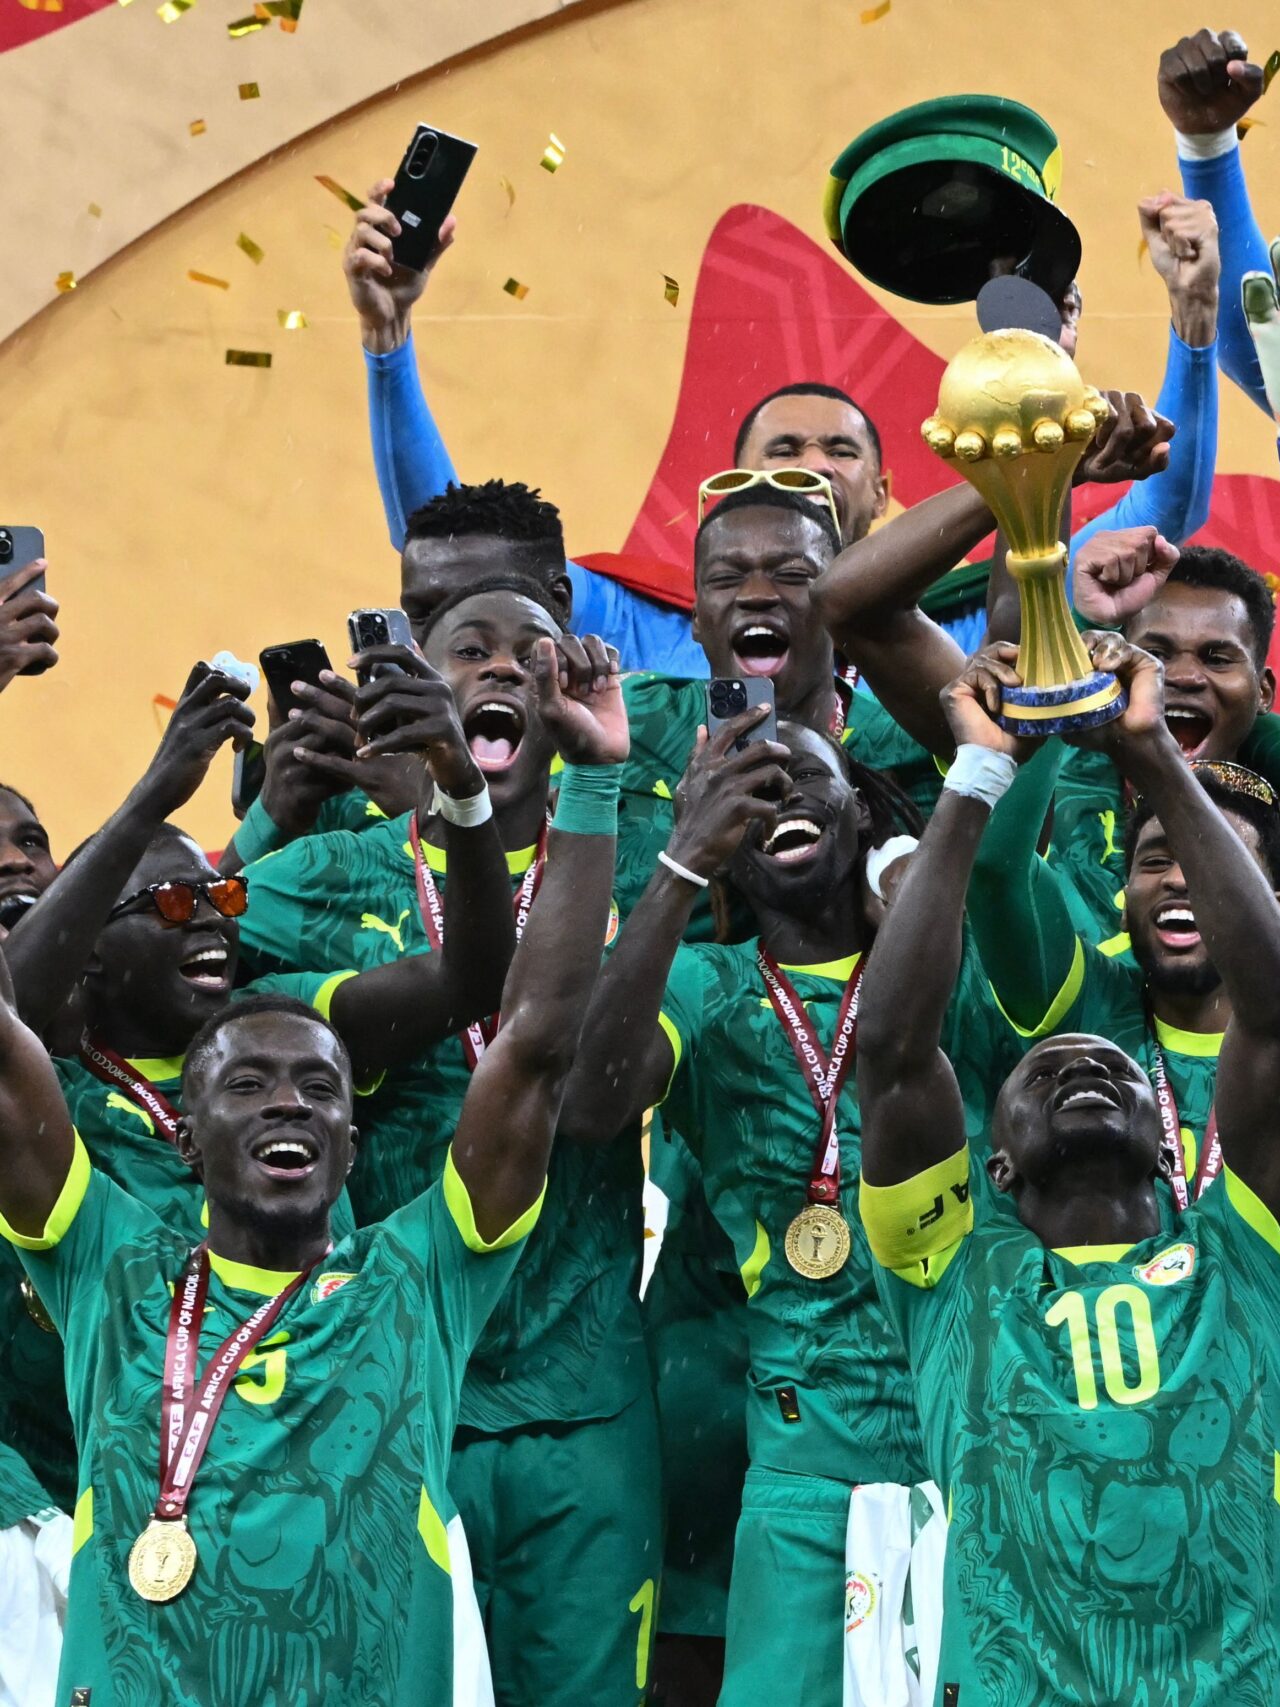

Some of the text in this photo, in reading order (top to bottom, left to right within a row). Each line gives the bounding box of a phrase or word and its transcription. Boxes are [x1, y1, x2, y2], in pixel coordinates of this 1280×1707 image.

[774, 988, 801, 1027] NATIONS
[794, 1028, 808, 1042] OF
[802, 1043, 818, 1064] CUP
[834, 1033, 850, 1056] CUP
[842, 1017, 853, 1035] OF
[179, 1309, 193, 1326] OF
[176, 1326, 190, 1351] CUP
[1045, 1284, 1160, 1410] 10
[172, 1354, 187, 1399] AFRICA
[184, 1420, 200, 1458] CAF
[201, 1364, 229, 1409] AFRICA
[222, 1342, 241, 1365] CUP
[236, 1323, 252, 1342] OF
